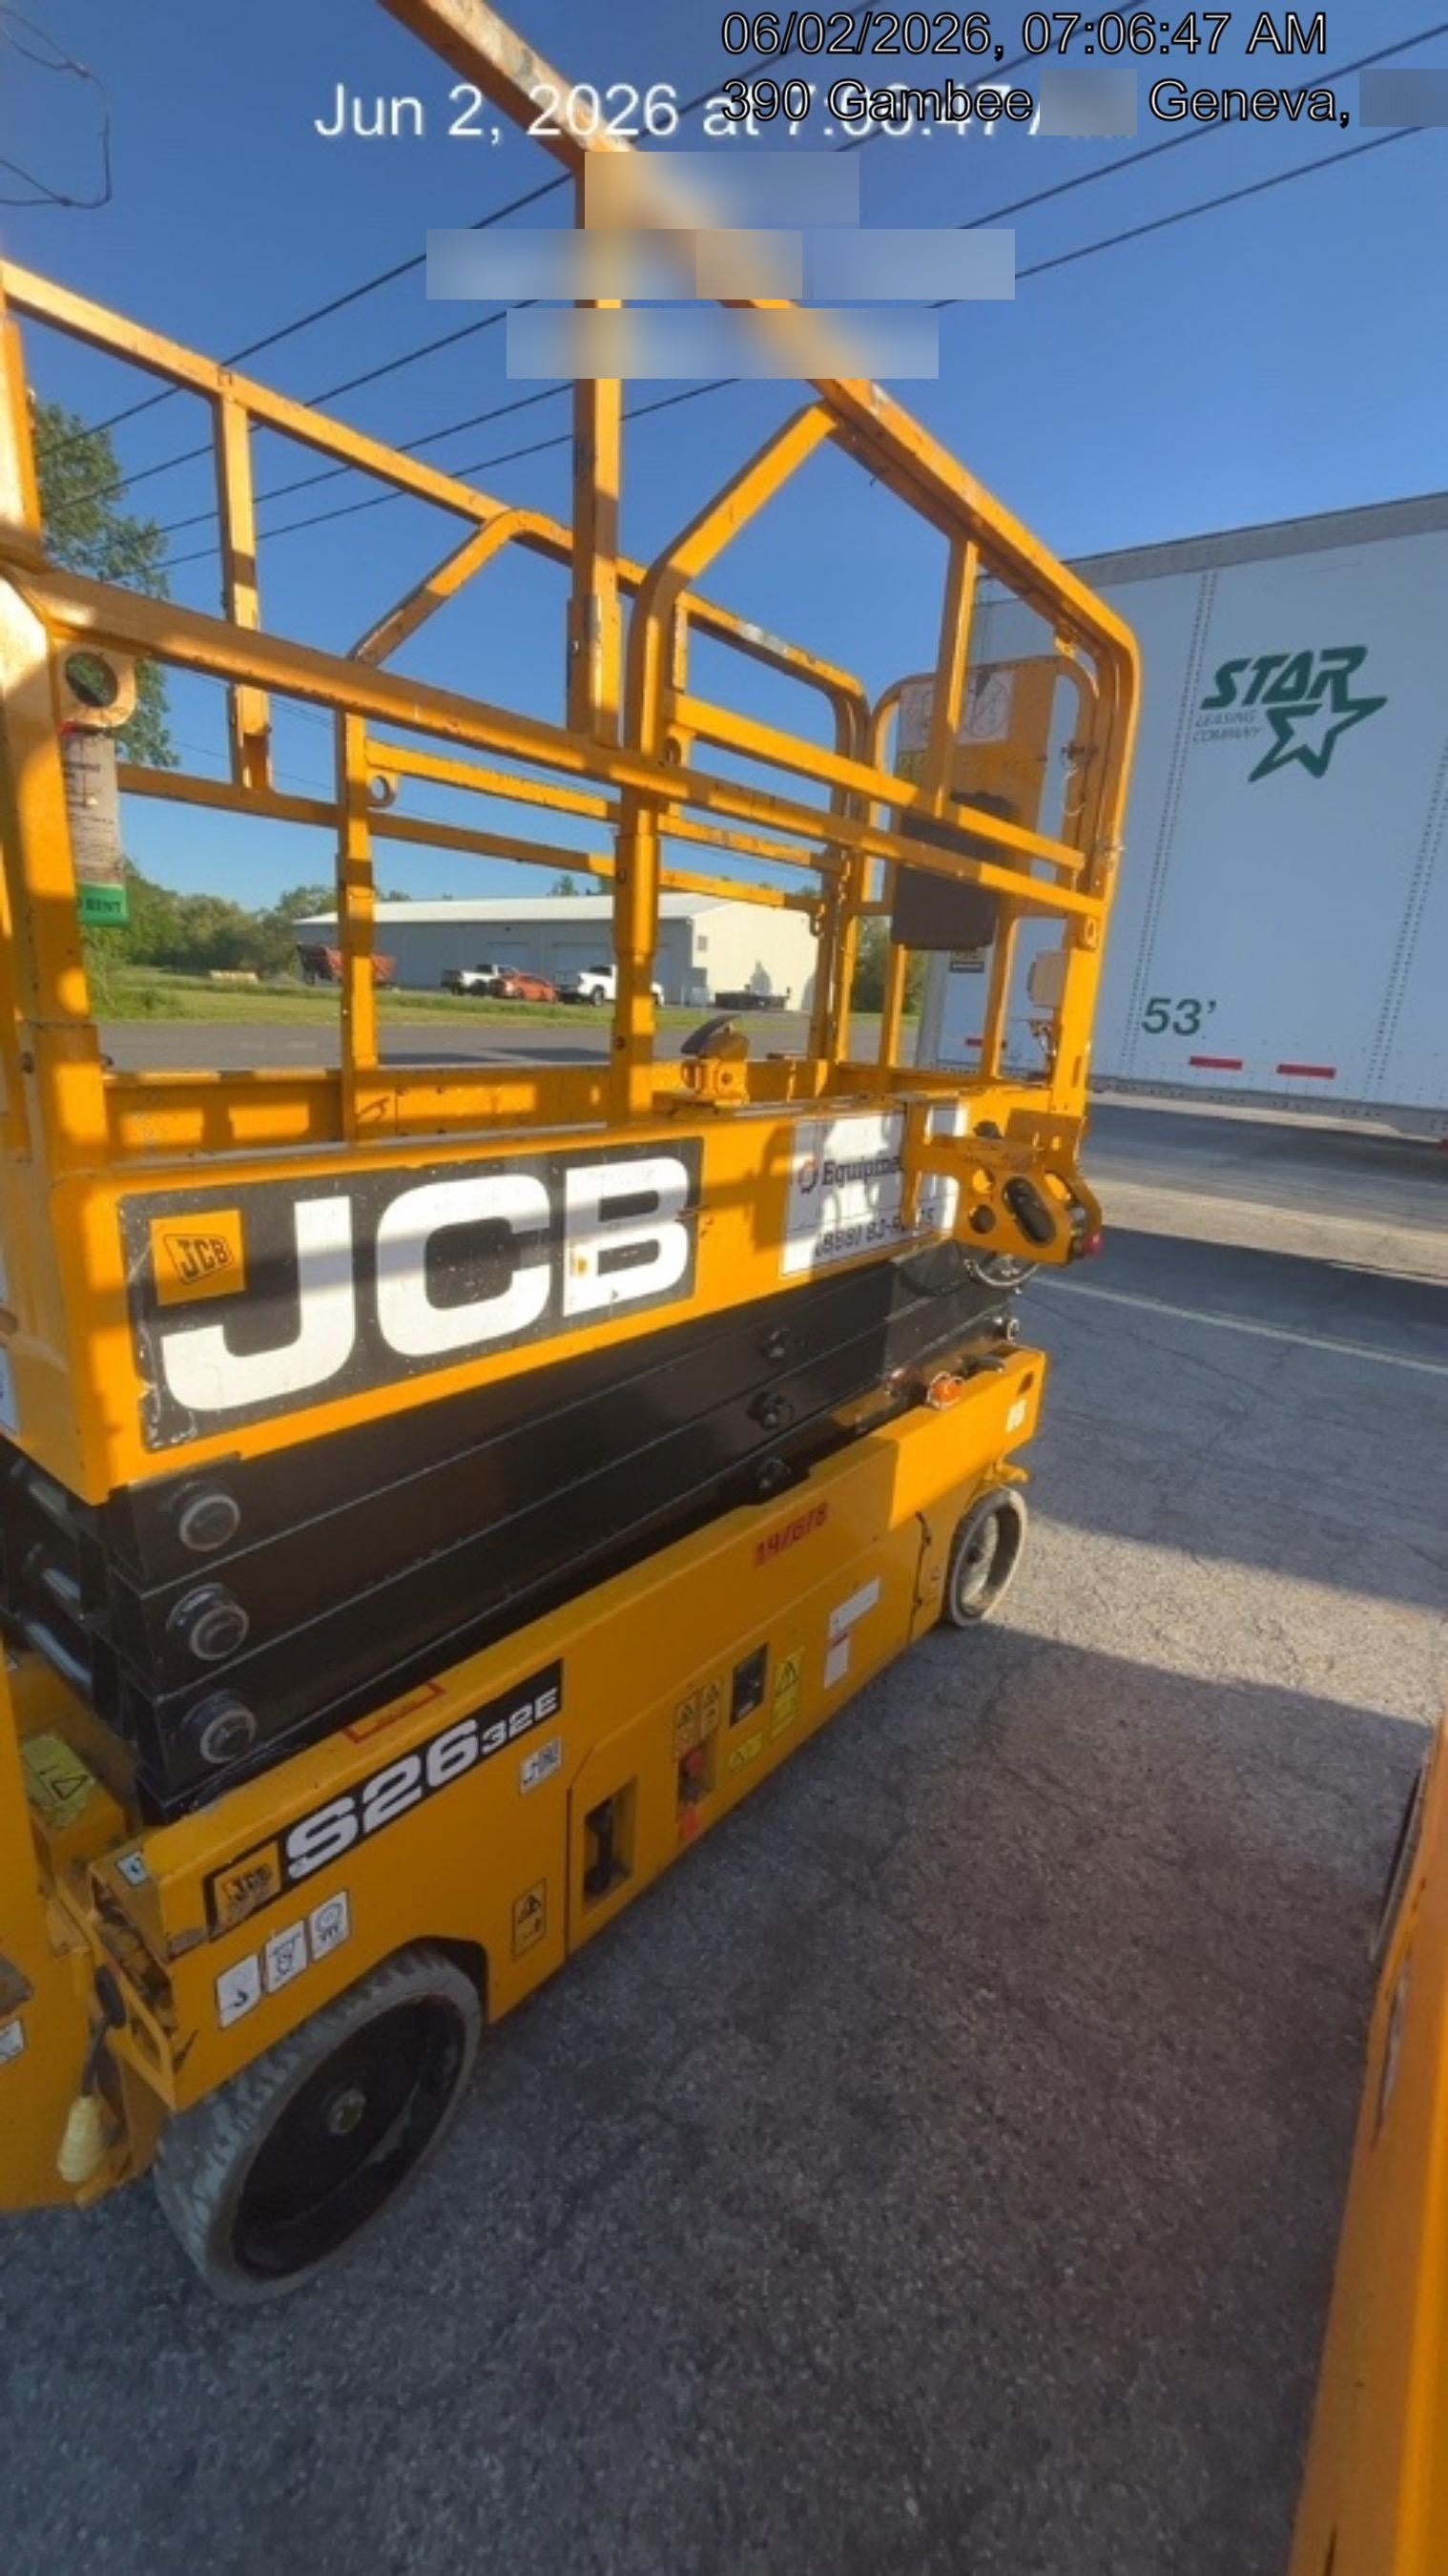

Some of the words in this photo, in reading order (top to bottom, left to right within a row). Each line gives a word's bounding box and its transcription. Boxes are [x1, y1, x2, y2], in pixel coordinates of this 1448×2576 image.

[1199, 645, 1369, 712] STAR
[1142, 998, 1217, 1037] 53'
[161, 1157, 689, 1411] JCB
[176, 1238, 229, 1277] JCB
